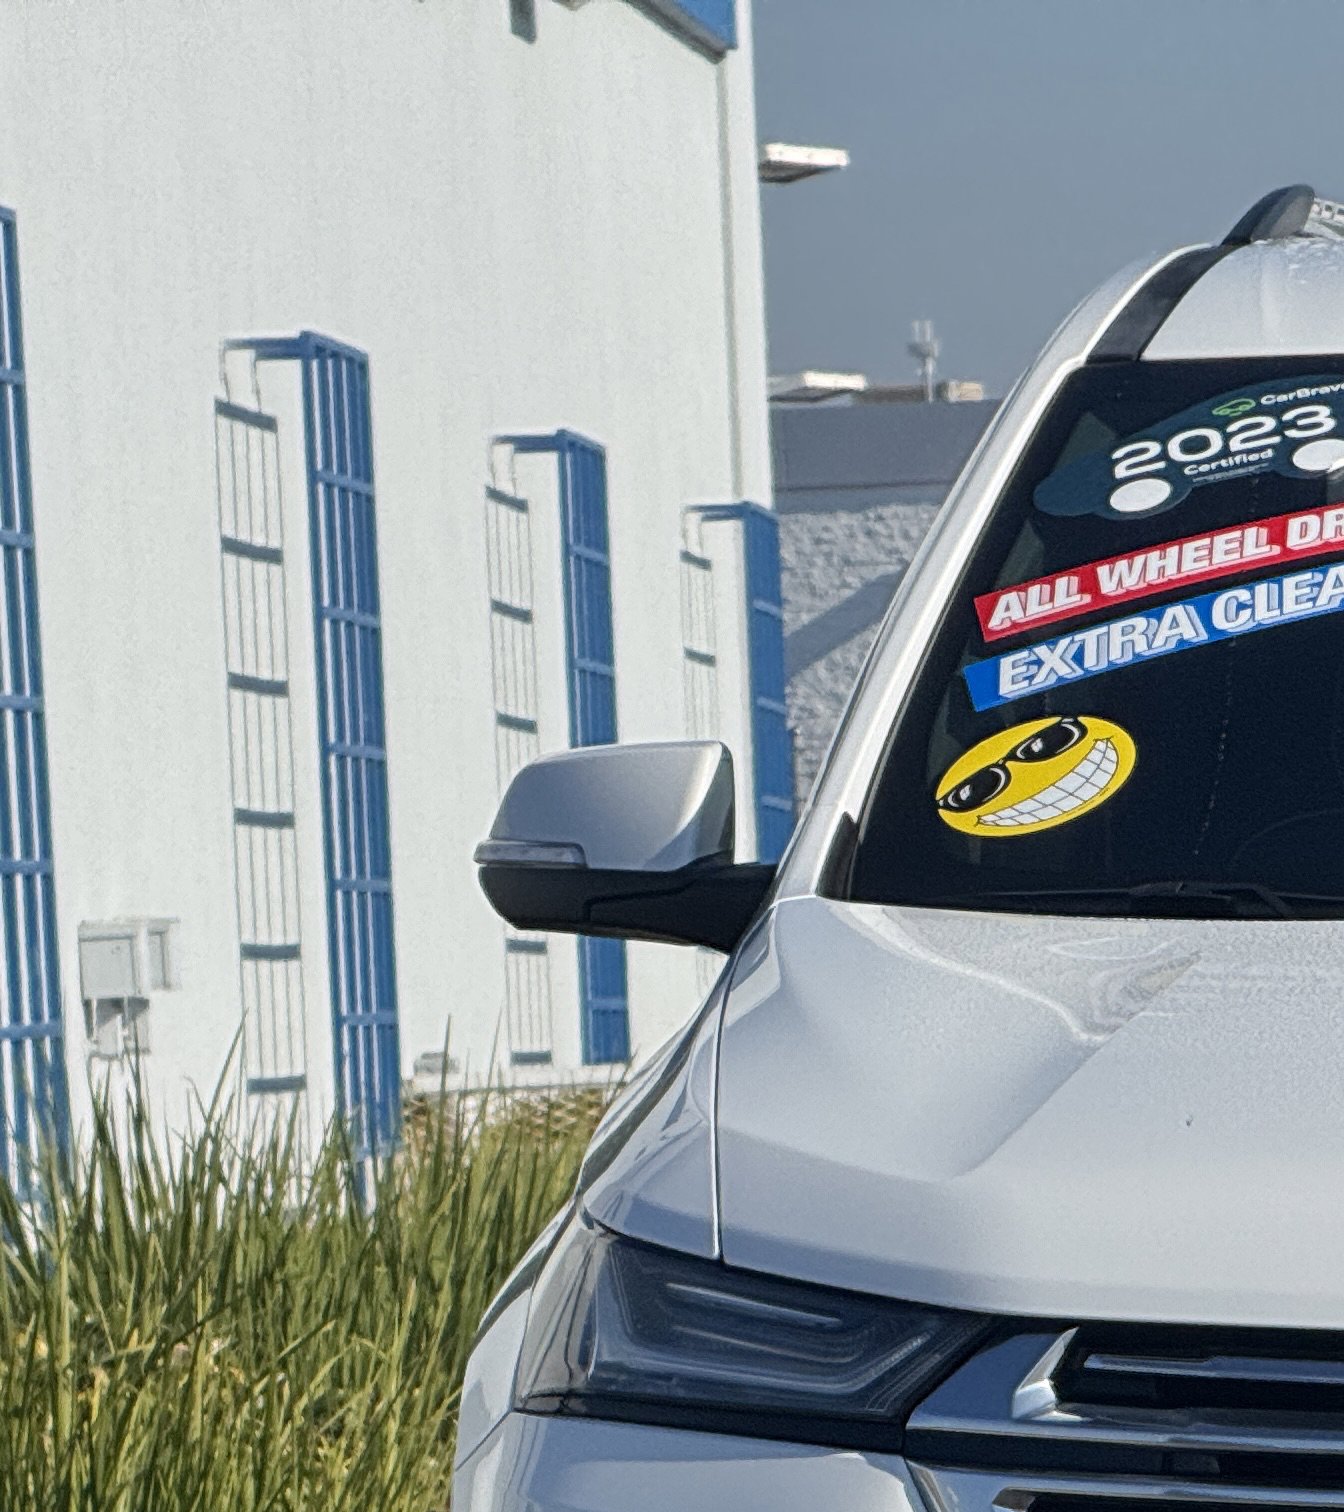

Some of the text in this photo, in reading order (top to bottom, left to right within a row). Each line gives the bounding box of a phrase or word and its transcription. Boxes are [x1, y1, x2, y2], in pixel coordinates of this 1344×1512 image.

[1111, 404, 1338, 479] 2023
[1183, 448, 1273, 476] Certified
[987, 575, 1092, 634] ALL
[1096, 525, 1282, 598] WHEEL
[998, 604, 1209, 699] EXTRA
